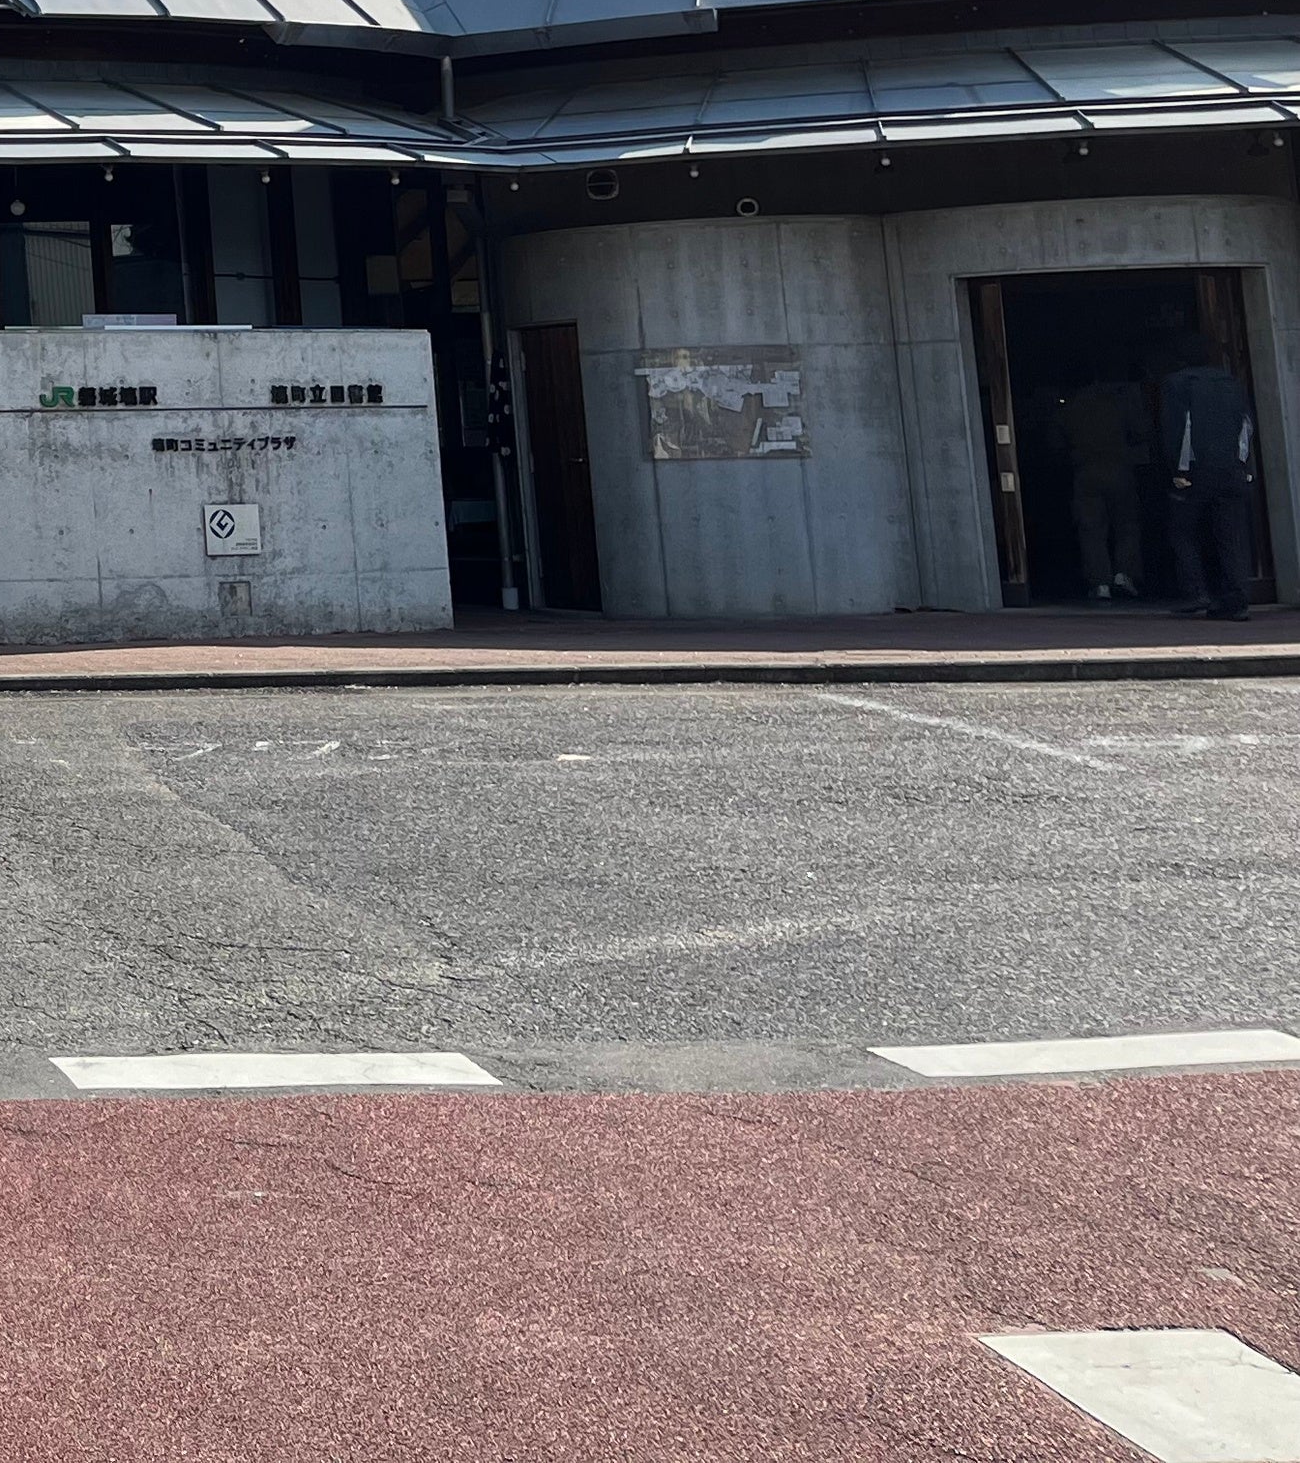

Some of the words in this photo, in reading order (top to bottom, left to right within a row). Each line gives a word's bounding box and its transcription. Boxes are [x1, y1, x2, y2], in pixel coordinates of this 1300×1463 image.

[39, 386, 74, 408] JR
[152, 437, 296, 453] 塙町コミュニティプラザ
